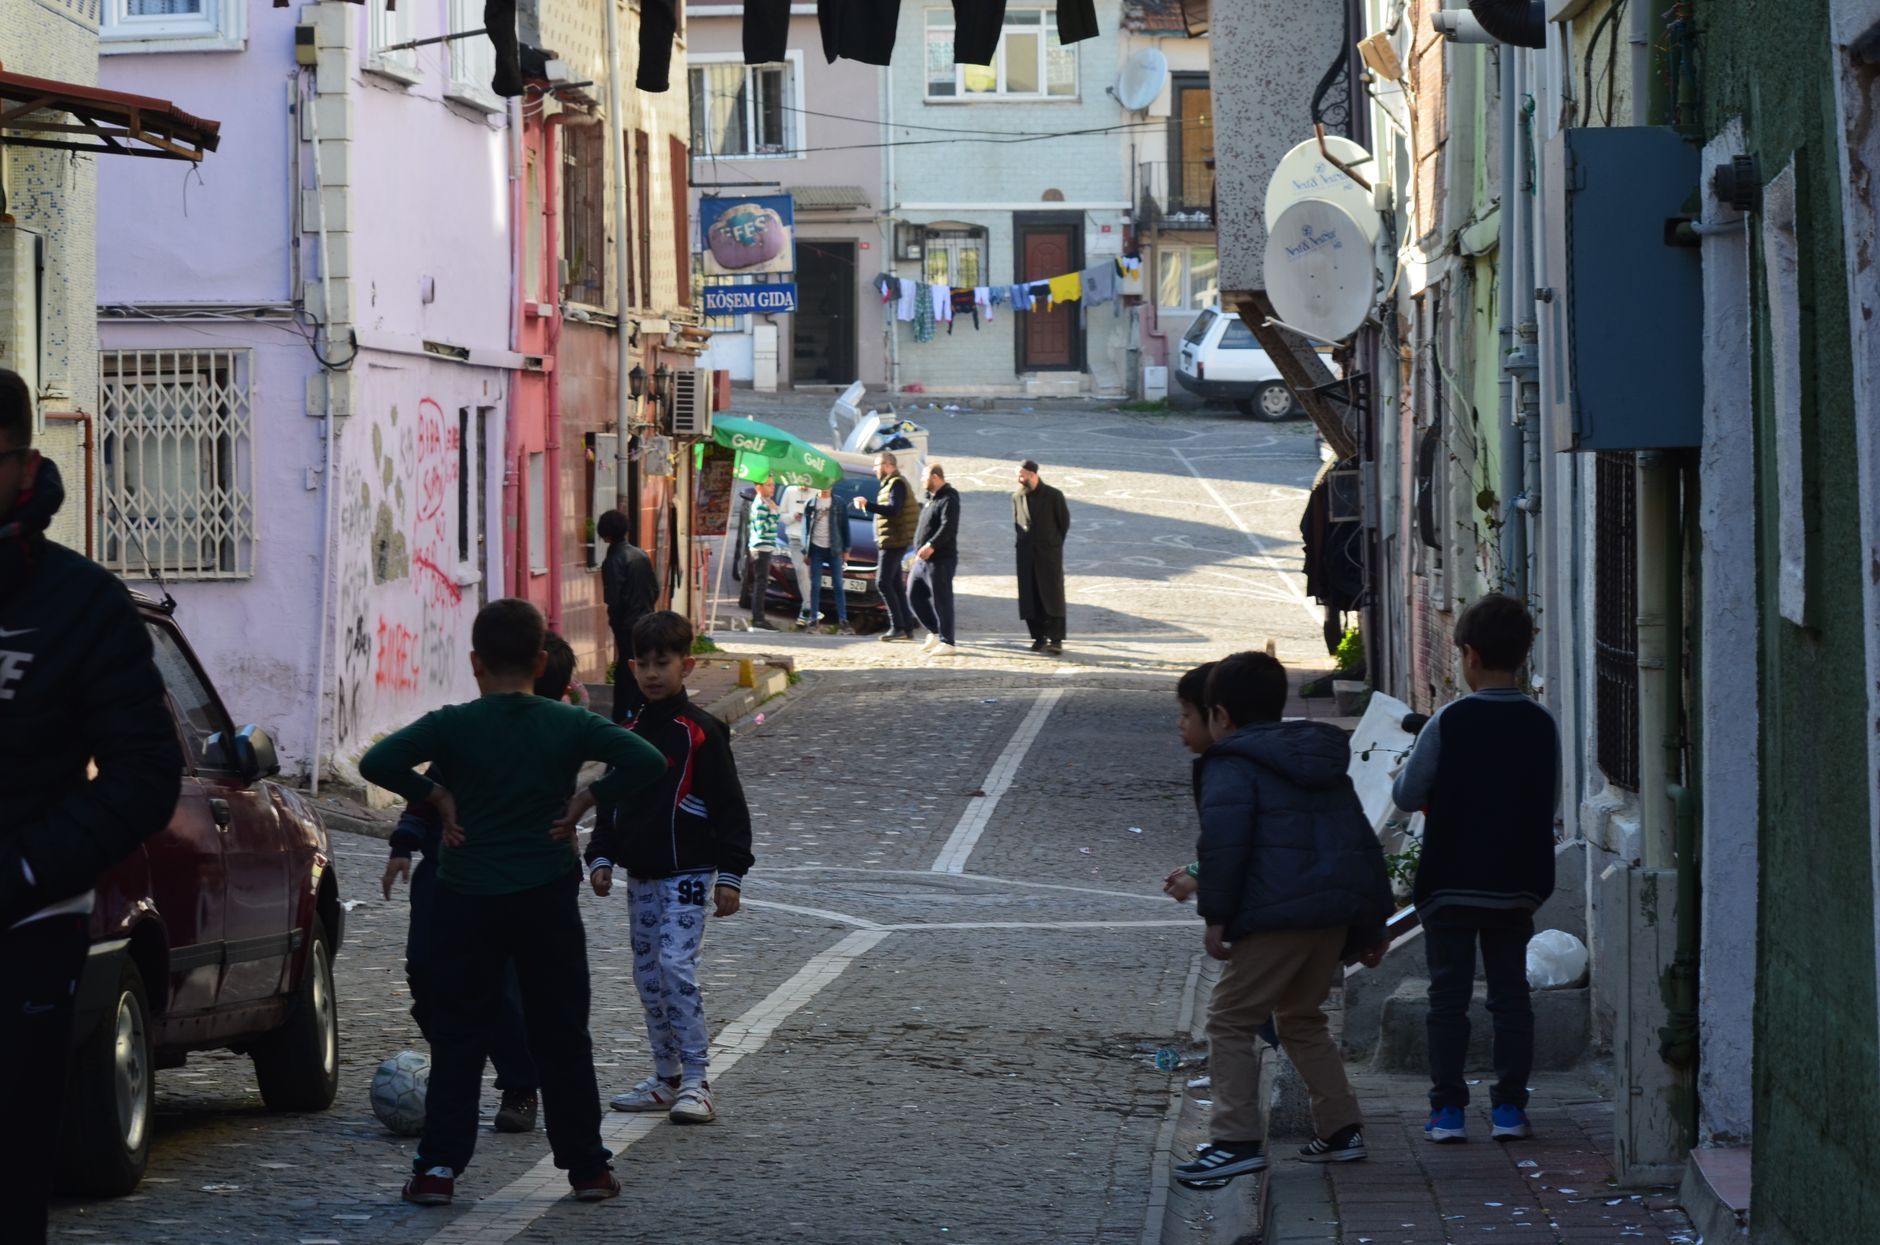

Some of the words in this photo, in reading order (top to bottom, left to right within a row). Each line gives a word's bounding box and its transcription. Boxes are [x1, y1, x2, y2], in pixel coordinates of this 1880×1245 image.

[719, 216, 769, 241] EFES
[706, 290, 755, 312] KÖŞEM
[757, 291, 795, 307] GIDA
[731, 432, 768, 453] Golf
[803, 451, 827, 473] Golf
[0, 649, 35, 700] E
[678, 880, 705, 906] 92
